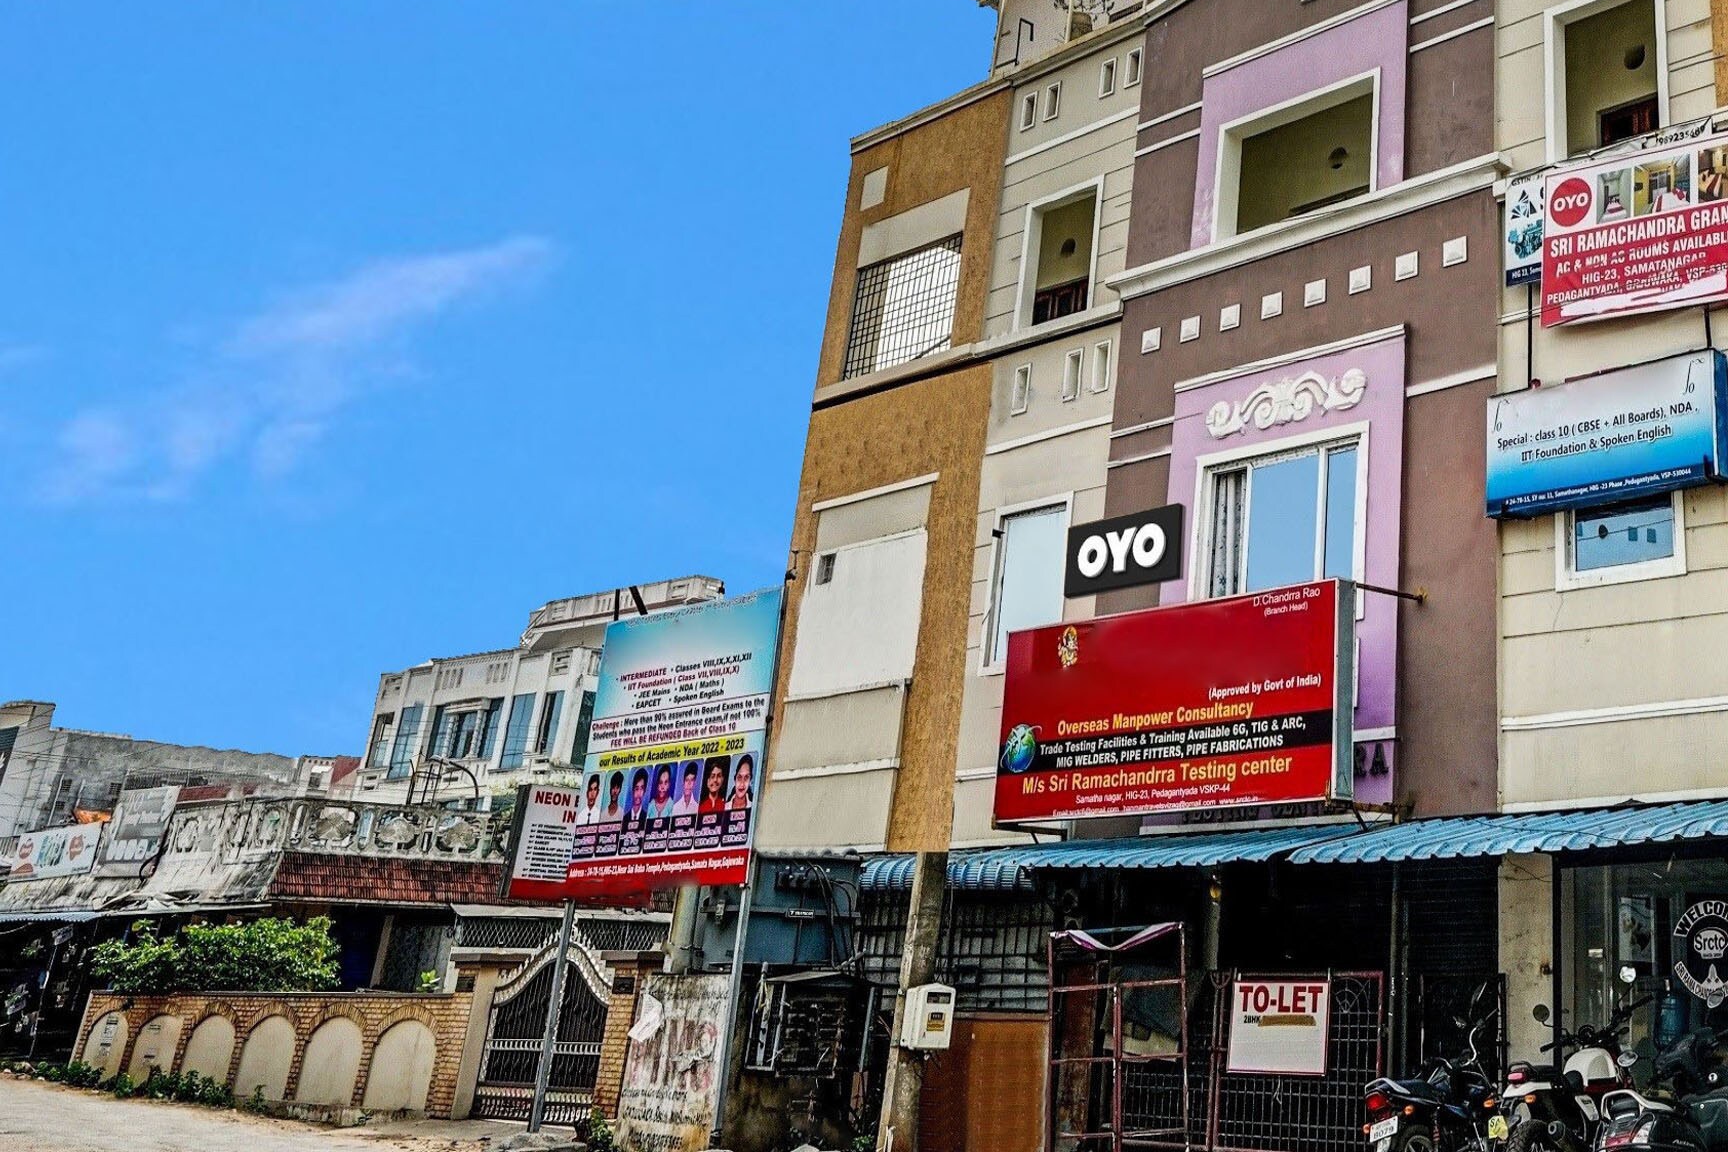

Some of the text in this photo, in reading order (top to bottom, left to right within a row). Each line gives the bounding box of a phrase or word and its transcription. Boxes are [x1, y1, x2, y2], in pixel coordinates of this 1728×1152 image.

[1553, 192, 1589, 212] OYO
[1551, 237, 1573, 258] SRI
[1577, 214, 1686, 253] RAMACHANDRA
[1556, 261, 1571, 278] AC
[1574, 259, 1582, 272] &
[1497, 432, 1527, 450] Special
[1534, 429, 1556, 441] class
[1558, 425, 1569, 437] 10
[1577, 419, 1600, 433] CBSE
[1613, 413, 1625, 427] All
[1521, 424, 1671, 462] IIT Foundation & Spoken English
[1077, 522, 1166, 578] OYO
[1253, 587, 1321, 607] D.Chandrra Rao
[1263, 600, 1308, 617] (Branch Head)
[620, 668, 668, 682] INTERMEDIATE
[675, 663, 700, 673] Classes
[627, 682, 637, 691] IIT
[638, 677, 672, 689] Foundation
[677, 674, 695, 682] Class
[635, 689, 724, 709] EAPCET Spoken English
[638, 679, 720, 698] JEE Mains NDA Maths
[1208, 673, 1321, 700] (Approved by Govt of India)
[592, 721, 620, 731] Challenge
[668, 708, 692, 721] assured
[694, 707, 699, 716] in
[701, 704, 720, 715] Board
[722, 701, 744, 711] Exams
[745, 699, 752, 708] to
[753, 698, 765, 706] the
[593, 730, 617, 740] Students
[675, 717, 703, 728] Entrance
[729, 712, 741, 720] not
[743, 708, 761, 719] 100%
[1057, 702, 1253, 736] Overseas Manpower Consultancy
[610, 738, 622, 748] FEE
[623, 736, 637, 746] WILL
[639, 734, 647, 744] BE
[648, 729, 682, 743] REFUNDED
[1040, 716, 1306, 756] Trade Testing Facilities & Training Available 6G, TIG & ARC,
[599, 738, 745, 767] our Results of Academic Year 2022 2023
[1056, 734, 1284, 768] MIG WELDERS, PIPE FITTERS, PIPE FABRICATIONS
[1022, 755, 1292, 795] M/s Sri Ramachandrra Testing center
[534, 790, 571, 807] NEON
[1104, 793, 1124, 804] nagar,
[1199, 783, 1231, 795] VSKP-44
[1695, 934, 1725, 951] Srctc
[1239, 985, 1323, 1013] TO-LET
